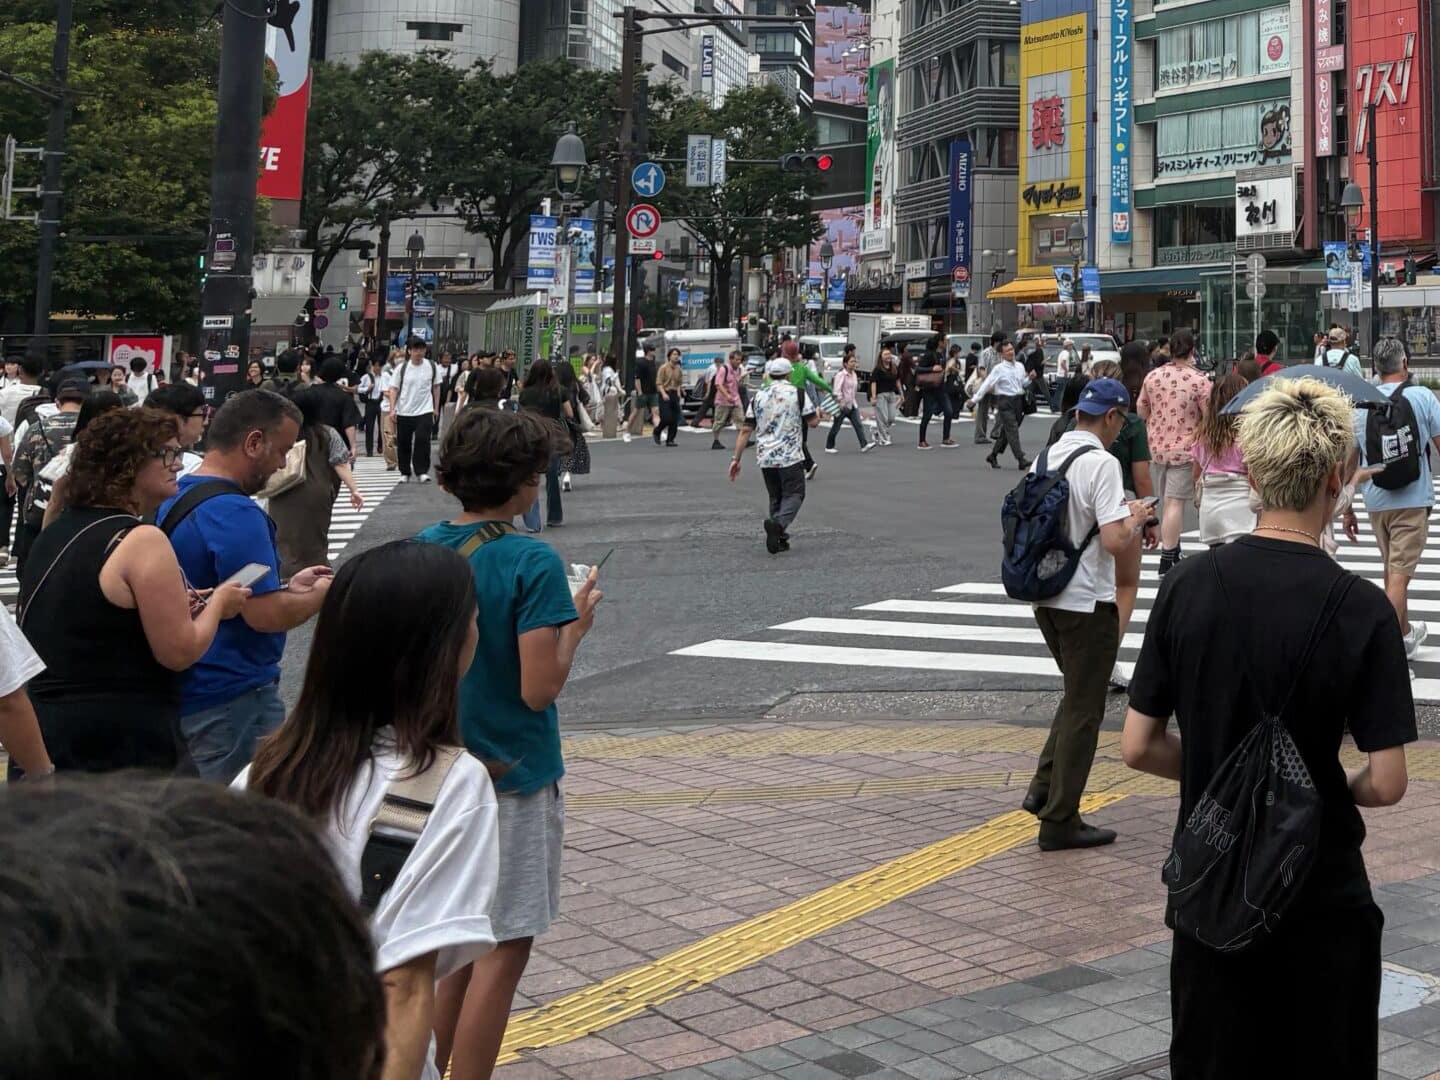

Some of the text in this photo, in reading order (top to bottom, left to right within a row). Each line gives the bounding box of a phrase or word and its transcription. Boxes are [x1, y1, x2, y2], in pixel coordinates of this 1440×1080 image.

[1024, 30, 1060, 45] Matsumoto
[1354, 31, 1417, 154] クスリ
[1031, 94, 1066, 151] 薬
[958, 152, 968, 192] MIZUHO
[529, 231, 555, 246] TWS
[523, 308, 535, 366] SMOKING
